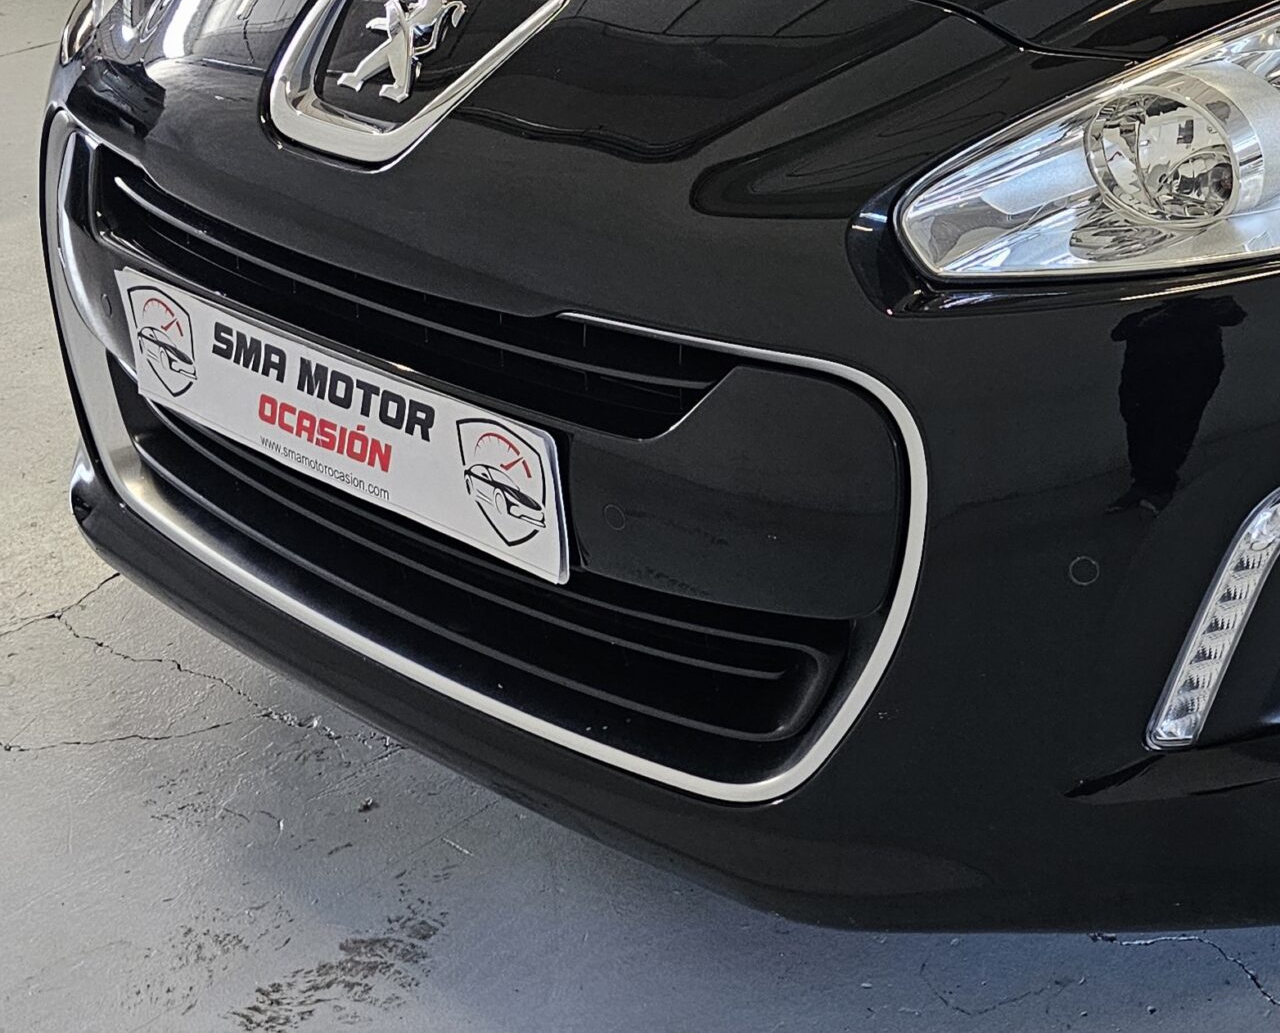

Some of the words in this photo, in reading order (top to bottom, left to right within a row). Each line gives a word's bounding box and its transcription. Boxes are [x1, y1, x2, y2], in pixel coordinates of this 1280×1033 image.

[212, 322, 286, 383] SMA
[297, 357, 435, 442] MOTOR
[258, 394, 392, 473] OCASIÓN
[260, 435, 389, 500] www.smamotorocasion.com
